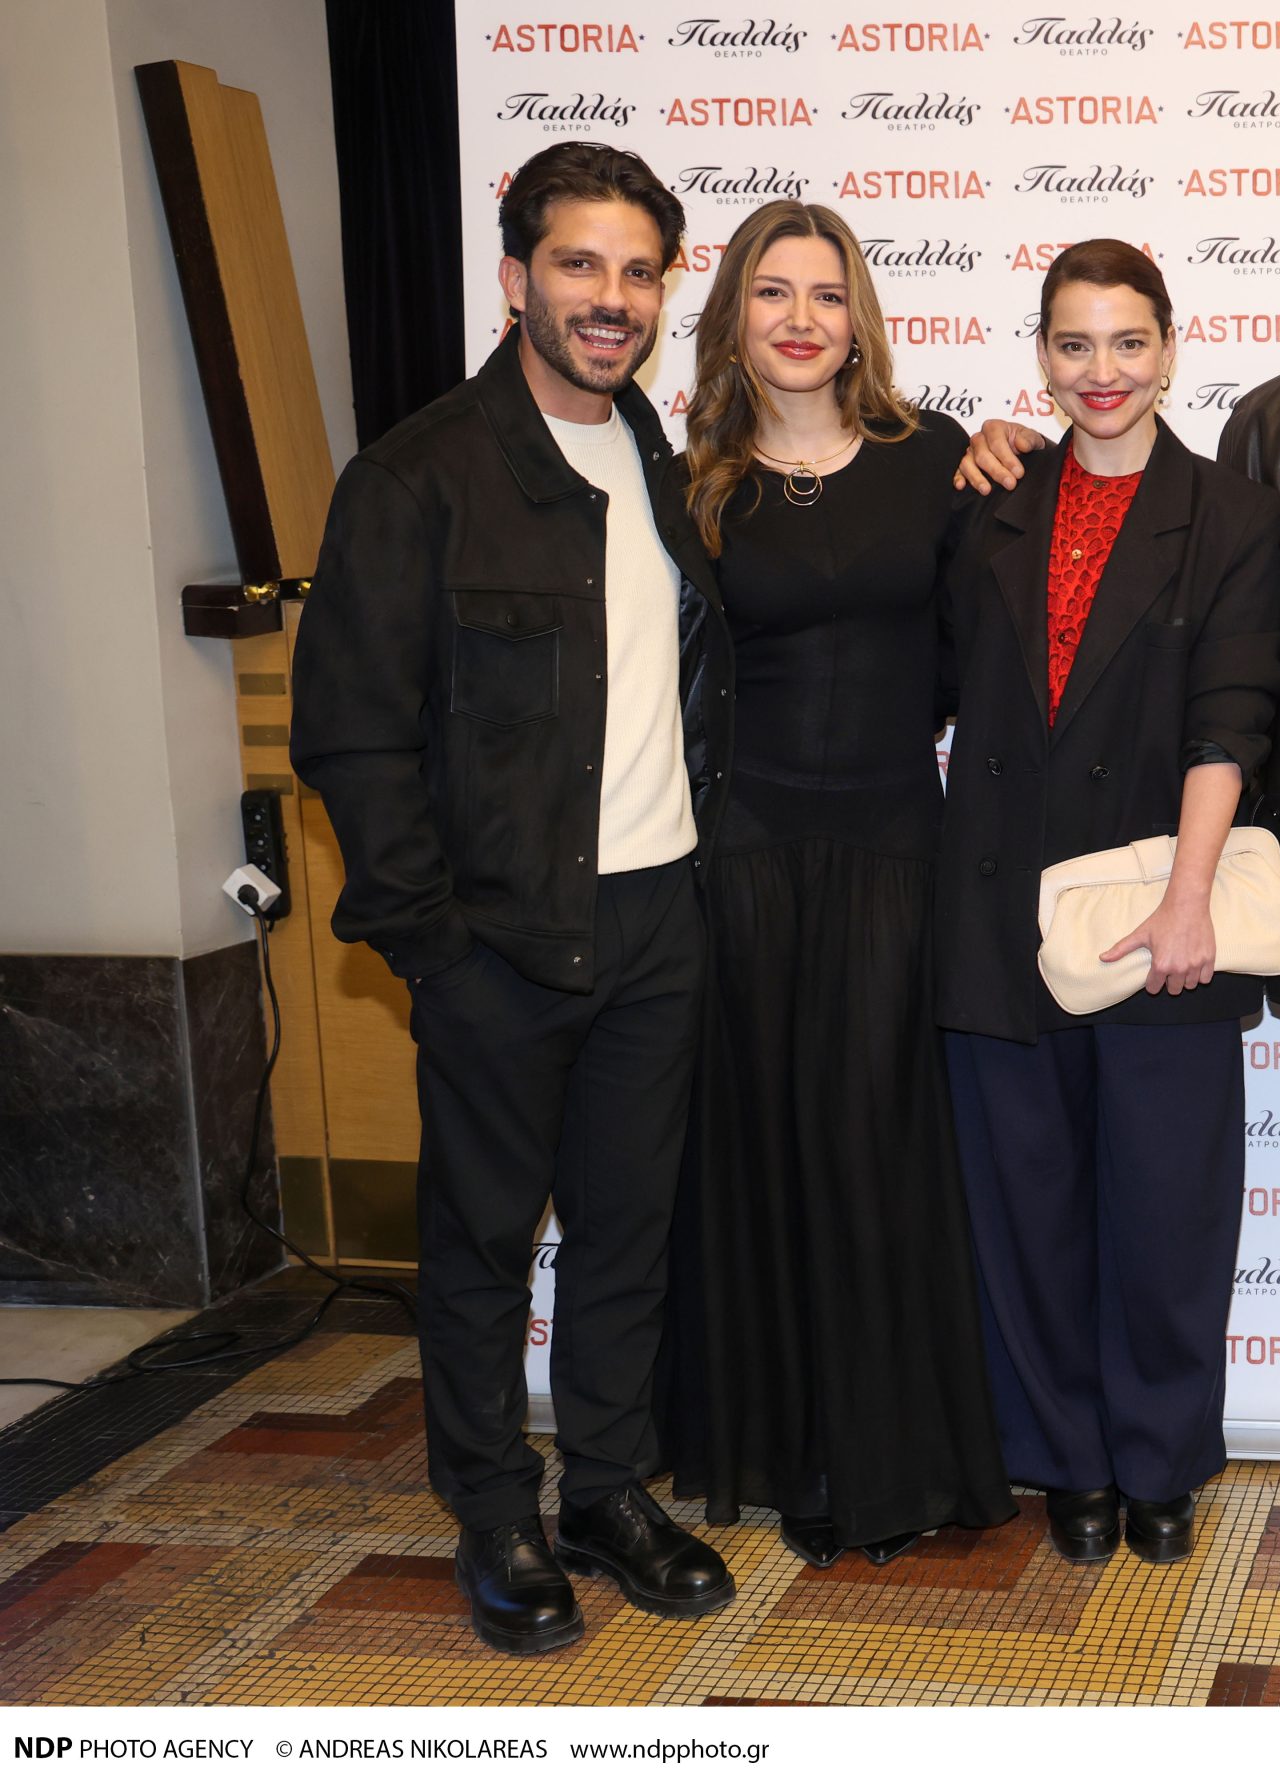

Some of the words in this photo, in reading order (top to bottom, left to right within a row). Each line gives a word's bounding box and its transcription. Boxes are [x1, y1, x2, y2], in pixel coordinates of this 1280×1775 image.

[491, 24, 639, 52] ASTORIA
[837, 23, 984, 52] ASTORIA
[714, 50, 763, 58] ΘΕΑΤΡΟ
[1060, 49, 1108, 57] ΘΕΑΤΡΟ
[665, 98, 813, 126] ASTORIA
[1010, 96, 1158, 125] ASTORIA
[543, 124, 592, 132] ΘΕΑΤΡΟ
[888, 123, 936, 131] ΘΕΑΤΡΟ
[839, 171, 986, 199] ASTORIA
[716, 197, 765, 205] ΘΕΑΤΡΟ
[1061, 196, 1109, 204] ΘΕΑΤΡΟ
[888, 270, 937, 278] ΘΕΑΤΡΟ
[885, 316, 986, 345] TORIA
[1247, 1140, 1280, 1149] ΑΤΡΟ
